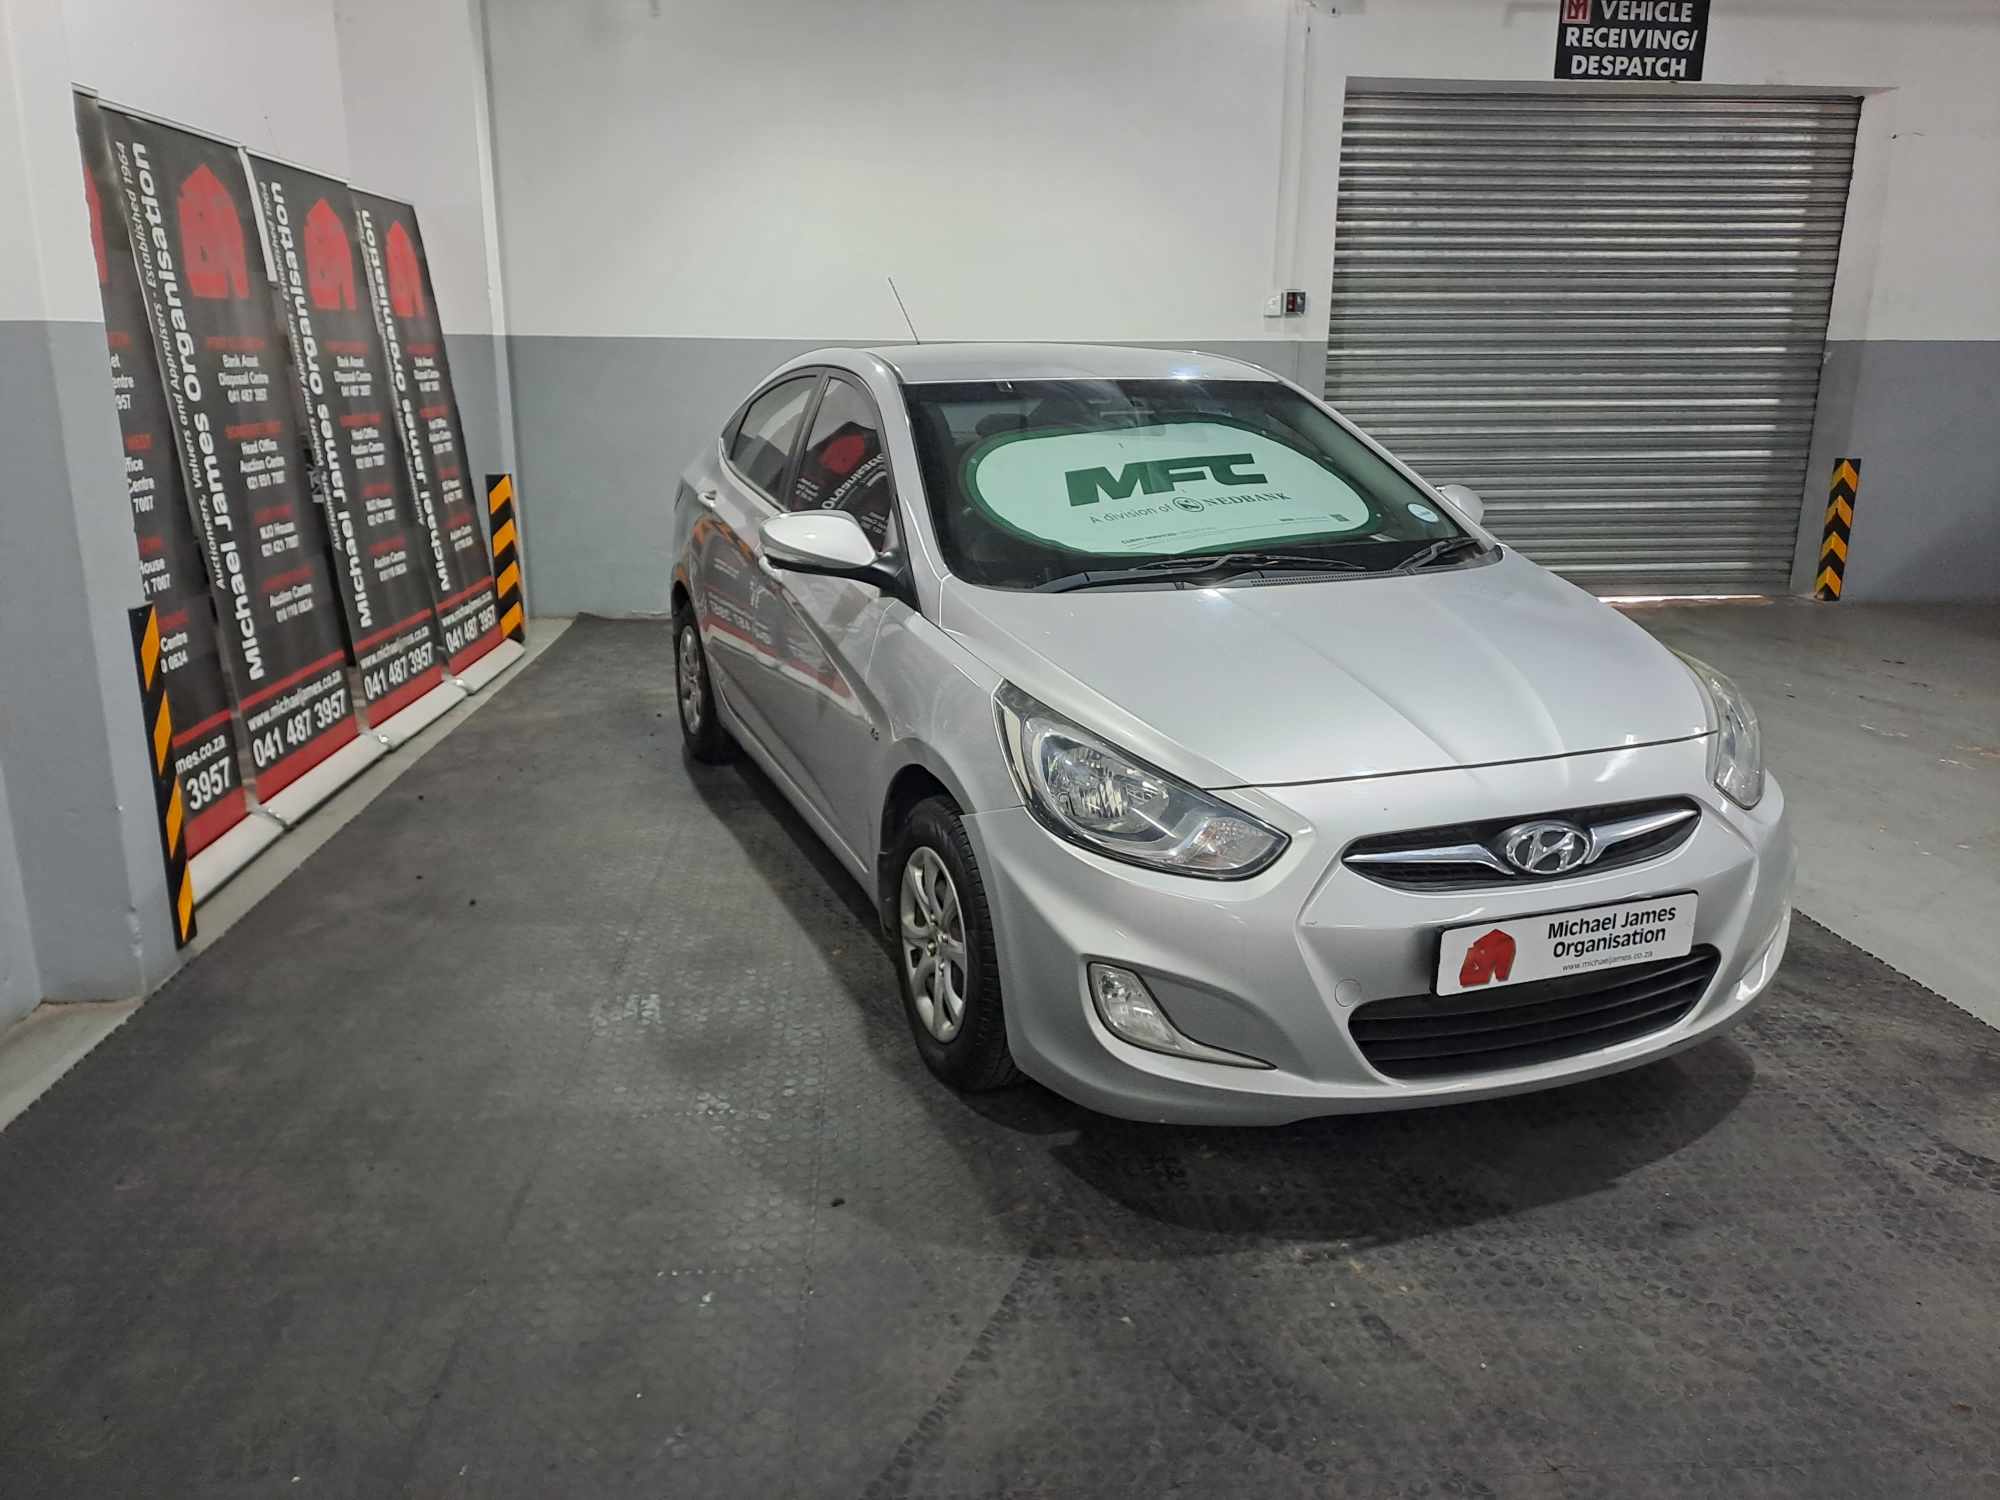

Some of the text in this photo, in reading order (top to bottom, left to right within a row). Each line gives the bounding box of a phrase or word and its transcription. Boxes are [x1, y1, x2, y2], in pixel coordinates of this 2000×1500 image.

[1565, 27, 1698, 50] RECEIVING/
[1601, 0, 1693, 23] VEHICLE
[1570, 55, 1687, 77] DESPATCH
[317, 404, 347, 503] James
[402, 399, 427, 484] James
[194, 413, 233, 532] James
[1065, 453, 1267, 507] MFC
[1089, 492, 1292, 524] A division of NEDBANK
[420, 491, 451, 591] Michael
[337, 510, 372, 628] Michael
[220, 541, 265, 681] Michael
[446, 627, 463, 653] 041
[463, 616, 478, 643] 487
[364, 641, 433, 700] 041 487 3957
[253, 726, 284, 767] 041
[287, 710, 313, 748] 487
[314, 689, 346, 729] 3957
[186, 756, 231, 810] 3957
[1548, 906, 1676, 940] Michael James
[1553, 926, 1666, 958] Organisation
